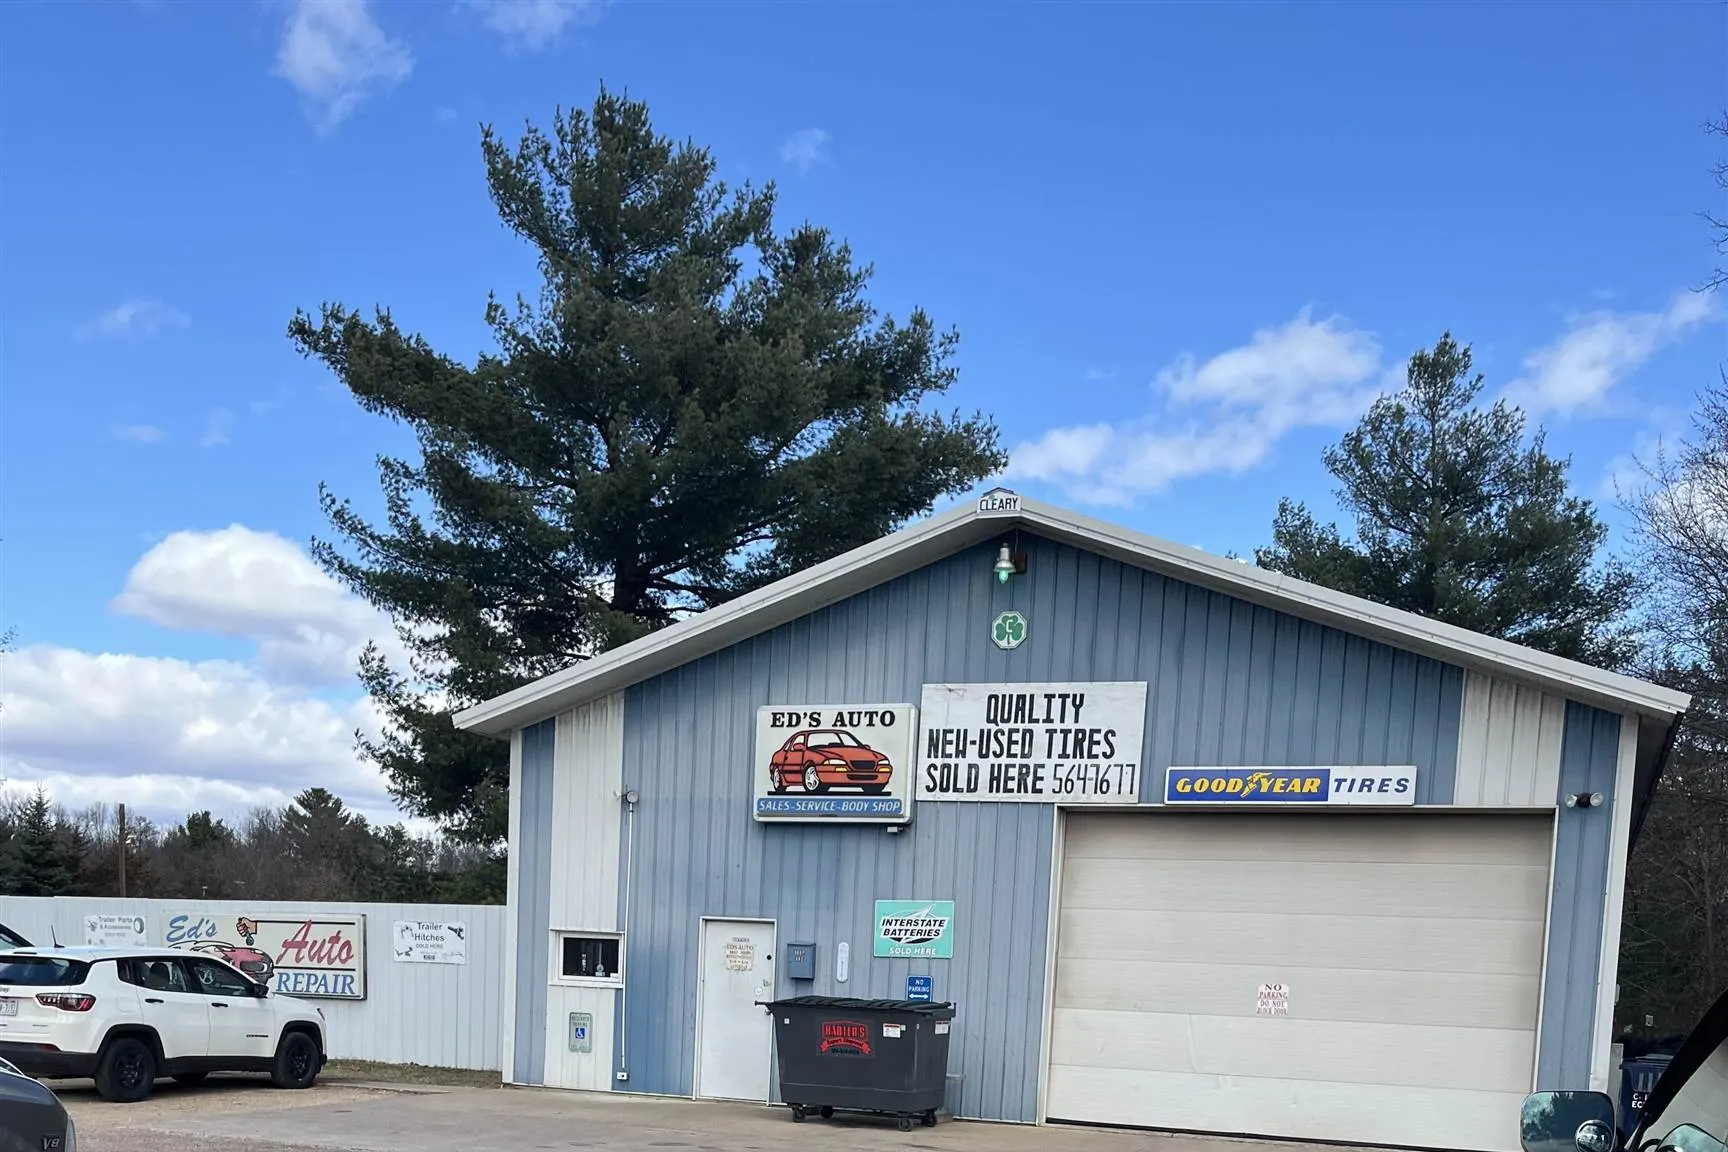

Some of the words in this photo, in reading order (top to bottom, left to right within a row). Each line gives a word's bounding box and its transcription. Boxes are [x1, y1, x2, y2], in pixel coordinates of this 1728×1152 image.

[979, 498, 1018, 511] CLEARY
[986, 693, 1085, 726] QUALITY
[770, 711, 822, 728] ED'S
[832, 710, 896, 728] AUTO
[927, 728, 1034, 759] NEW-USED
[1045, 728, 1117, 760] TIRES
[925, 763, 980, 793] SOLD
[988, 763, 1045, 794] HERE
[1334, 777, 1410, 793] TIRES
[872, 801, 900, 812] SHOP
[166, 915, 217, 942] Ed's
[417, 922, 442, 930] Trailer
[881, 918, 946, 928] INTERSTATE
[414, 933, 445, 941] Hitches
[883, 928, 941, 937] BATTERIES
[276, 919, 354, 966] Auto
[890, 947, 912, 955] SOLD
[914, 947, 936, 955] HERE
[277, 972, 357, 995] REPAIR
[42, 1136, 60, 1150] V8
